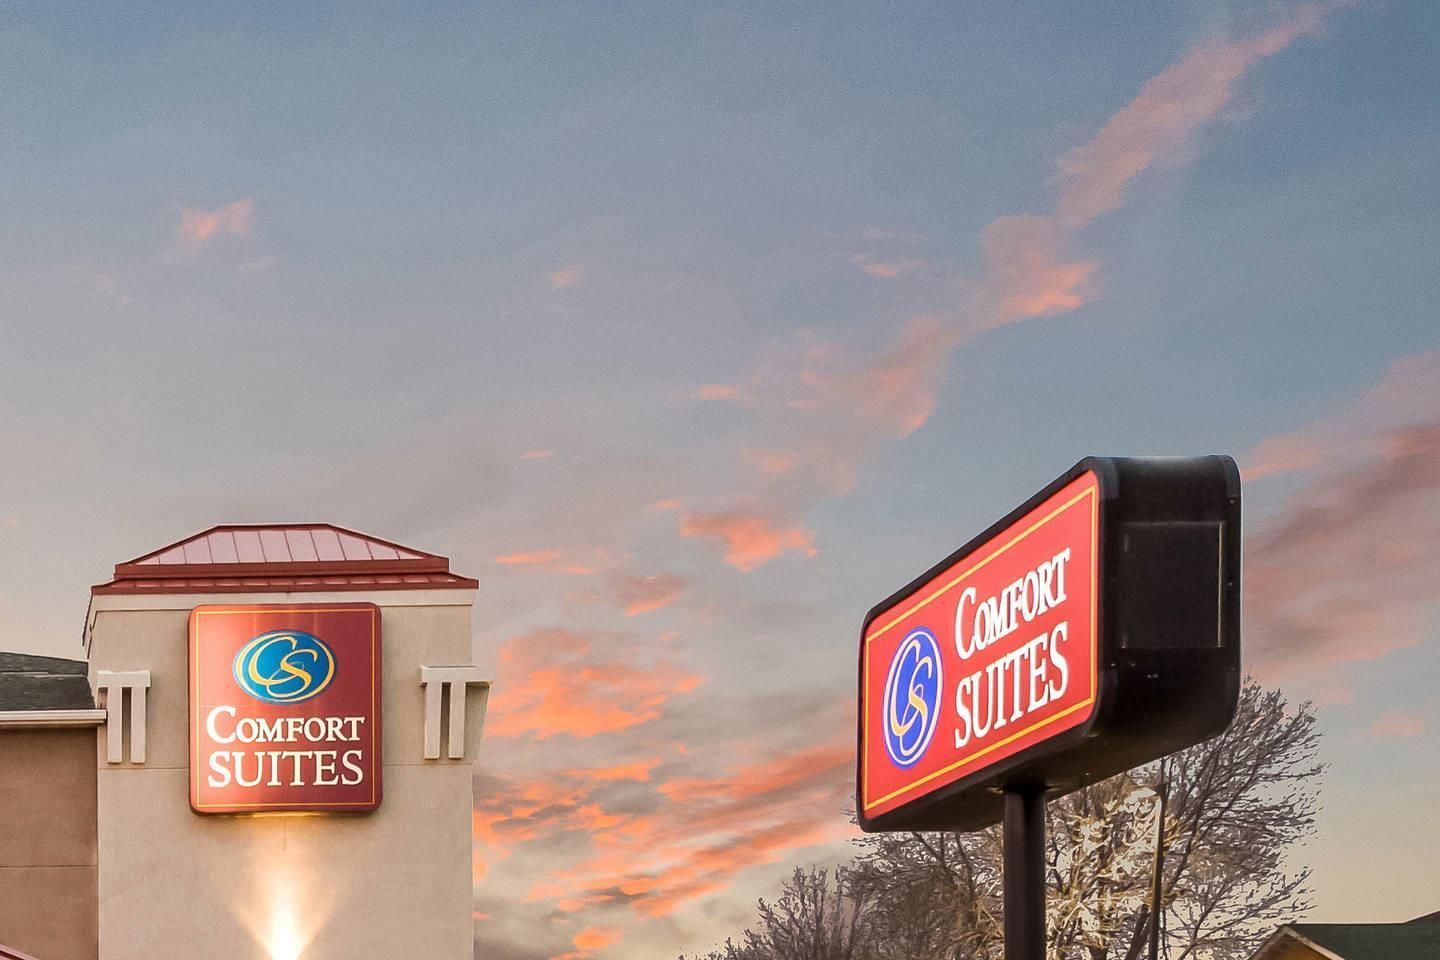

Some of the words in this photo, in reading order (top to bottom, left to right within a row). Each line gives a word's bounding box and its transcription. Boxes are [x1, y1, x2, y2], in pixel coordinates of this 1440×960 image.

[954, 547, 1071, 660] COMFORT
[954, 621, 1069, 749] SUITES
[206, 705, 365, 744] COMFORT
[207, 749, 364, 788] SUITES
